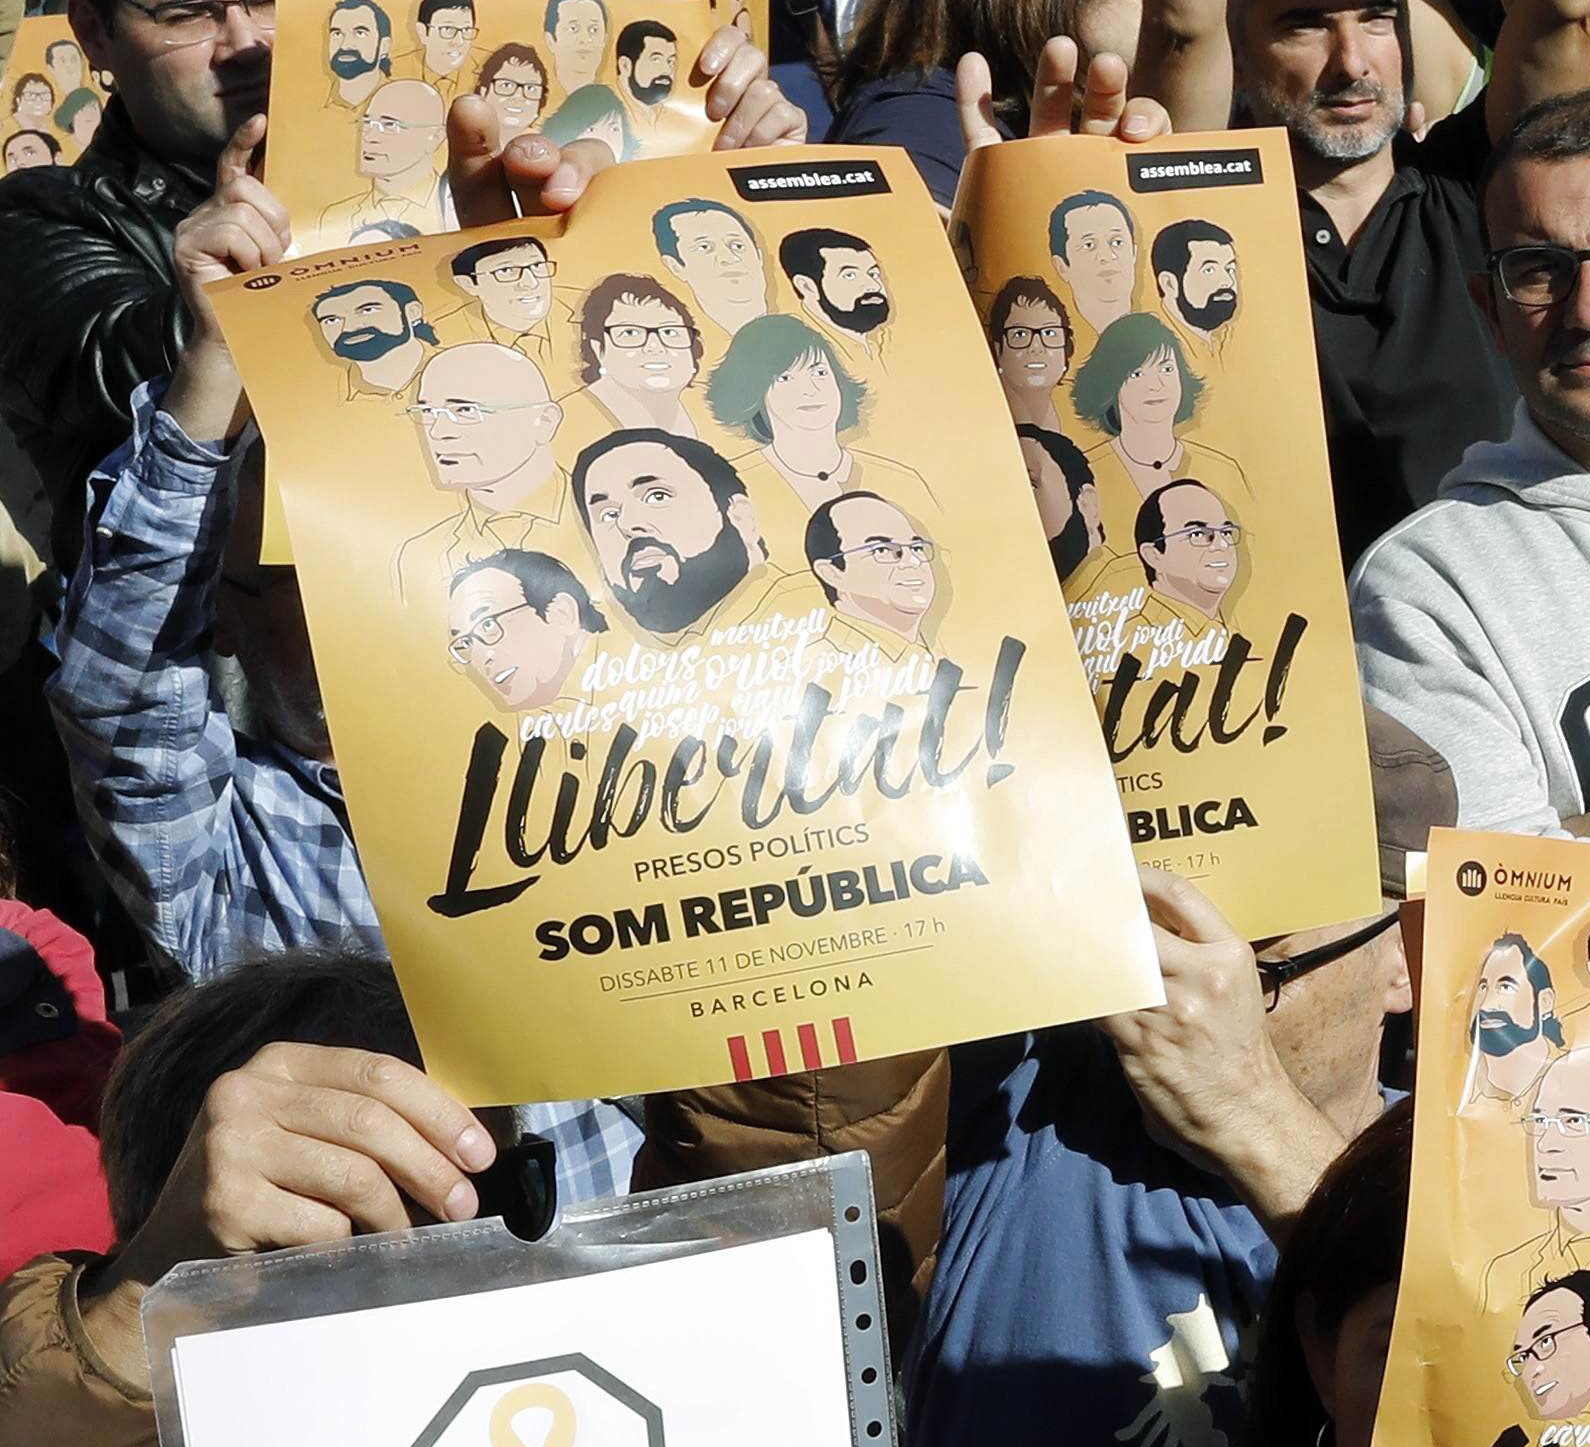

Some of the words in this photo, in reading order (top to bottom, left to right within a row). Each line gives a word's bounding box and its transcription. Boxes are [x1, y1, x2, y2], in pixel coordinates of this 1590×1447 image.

[747, 167, 875, 194] assemblea.cat
[1140, 157, 1252, 179] assemblea.cat
[427, 635, 1027, 919] Llibertat!
[634, 834, 738, 883] PRESOS
[750, 822, 871, 861] POLÍTICS
[1493, 861, 1573, 892] ÒMNIUM
[535, 905, 671, 962] SOM
[683, 844, 990, 939] REPÚBLICA
[690, 970, 875, 1019] BARCELONA
